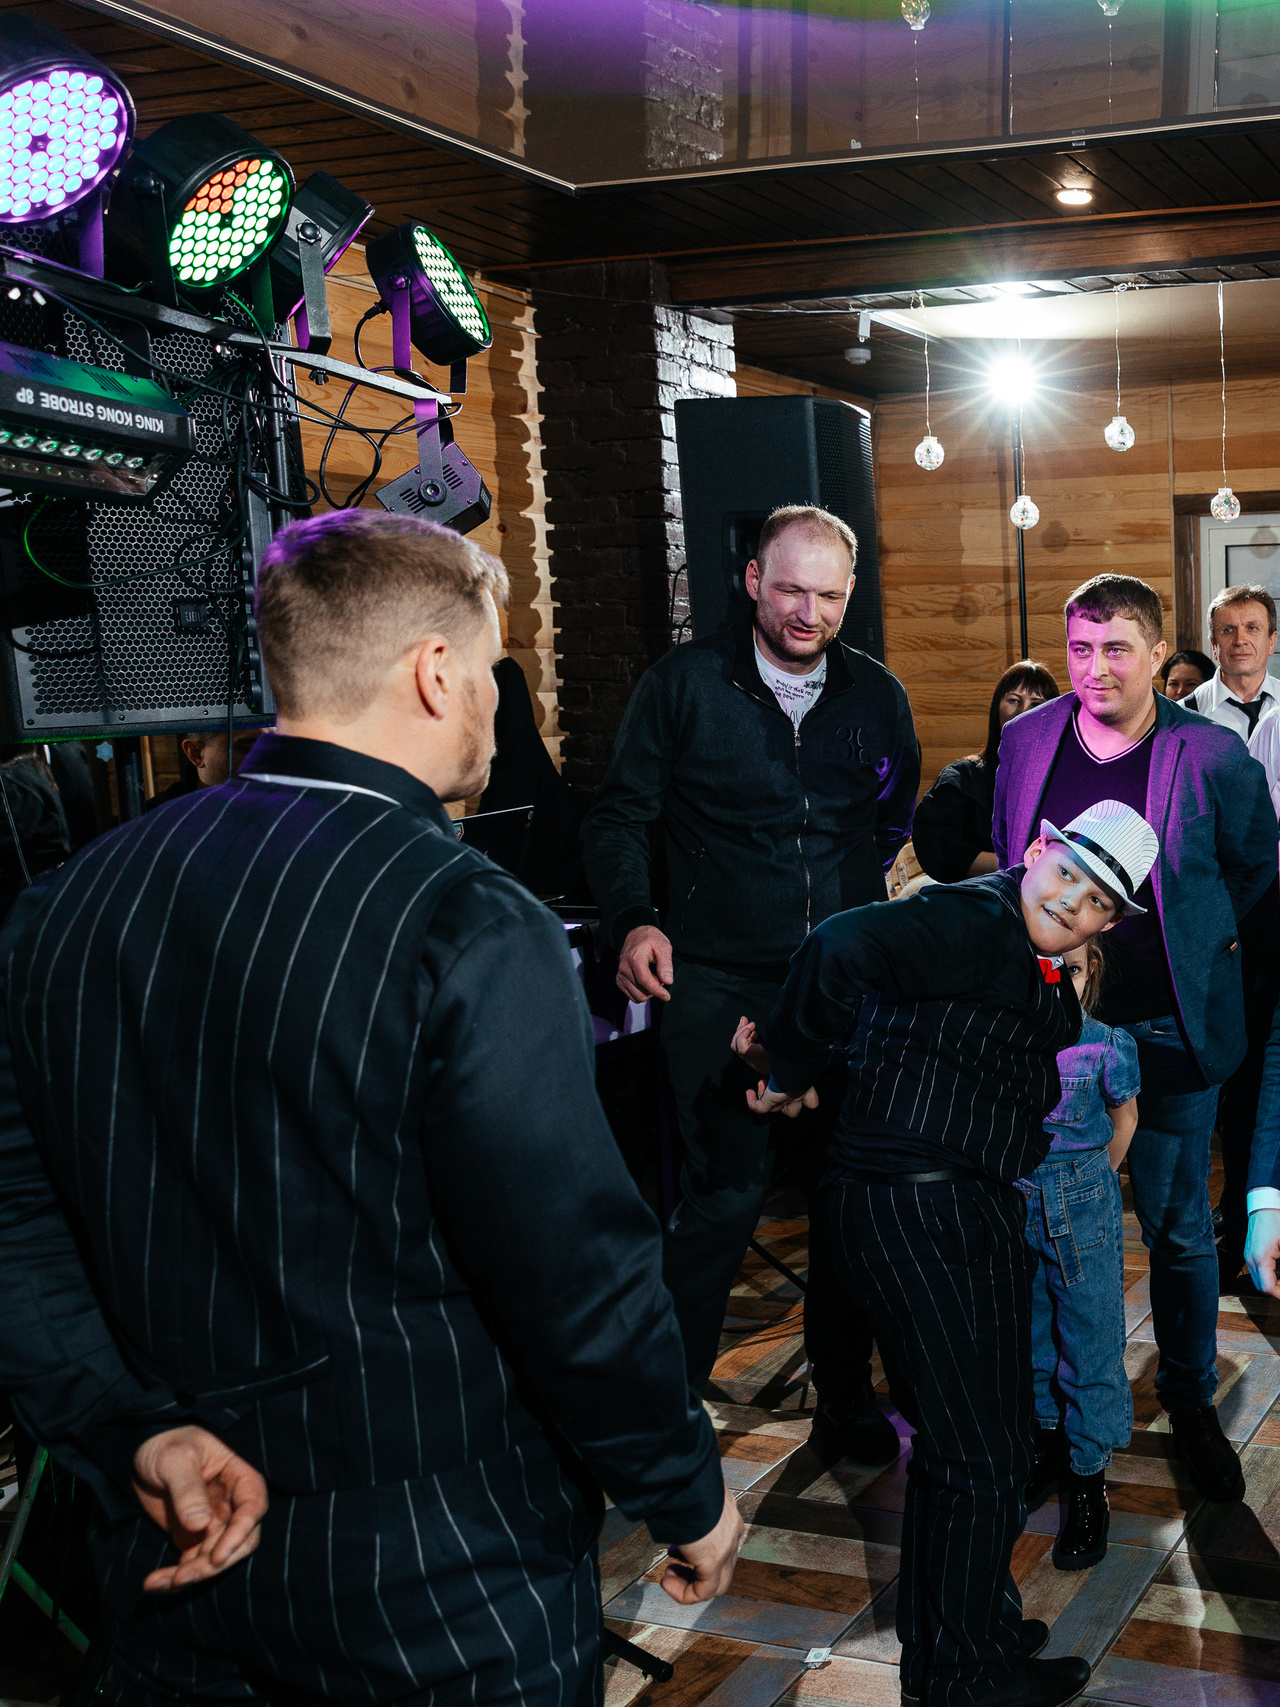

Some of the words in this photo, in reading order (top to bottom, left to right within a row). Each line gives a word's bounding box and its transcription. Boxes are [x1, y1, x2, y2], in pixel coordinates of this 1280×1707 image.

[15, 386, 35, 405] 8P
[39, 391, 95, 418] STROBE
[97, 405, 133, 427] KONG
[136, 415, 165, 434] KING
